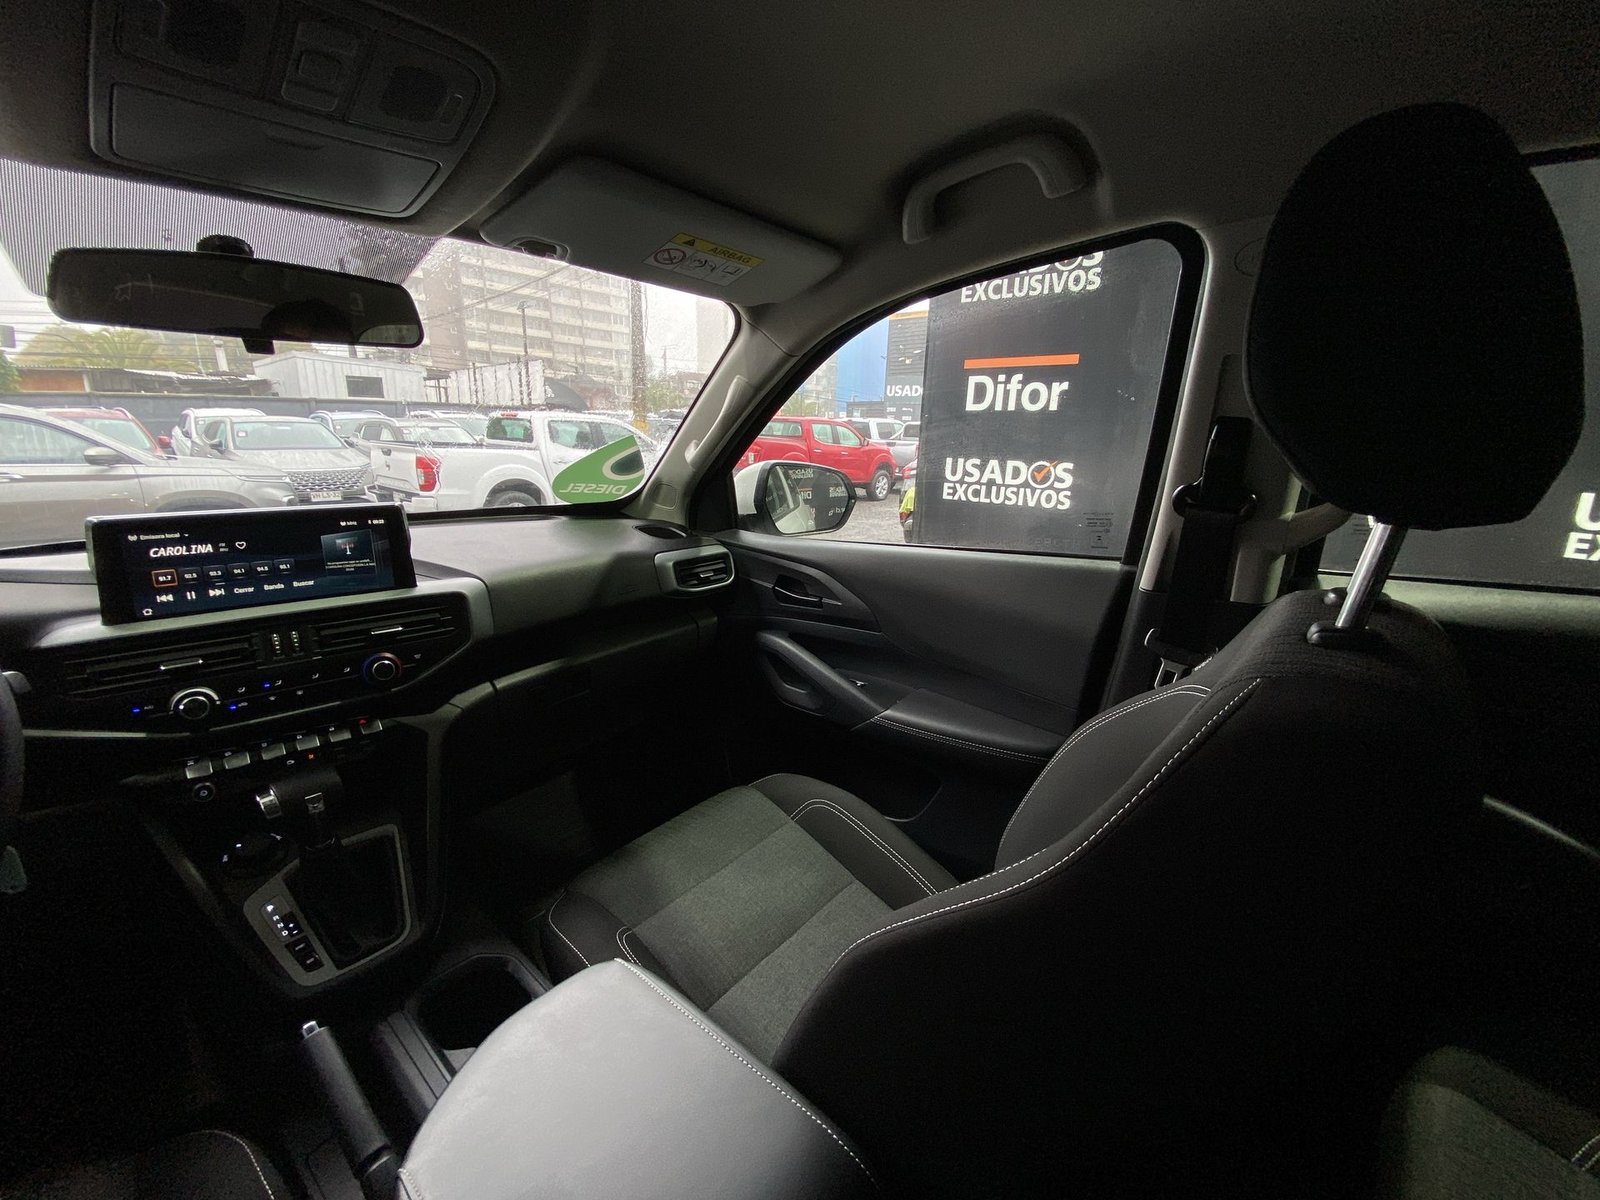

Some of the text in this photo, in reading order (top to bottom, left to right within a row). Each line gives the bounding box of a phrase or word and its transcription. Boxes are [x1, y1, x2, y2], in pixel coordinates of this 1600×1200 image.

[710, 247, 753, 264] AIRBAG
[961, 267, 1102, 303] EXCLUSIVOS
[886, 385, 923, 397] USAD
[965, 373, 1070, 412] Difor
[944, 457, 1074, 489] USADOS
[942, 482, 1072, 510] EXCLUSIVOS
[149, 544, 213, 557] CAROLINA
[233, 586, 255, 594] Cerrar
[263, 582, 285, 591] Banda
